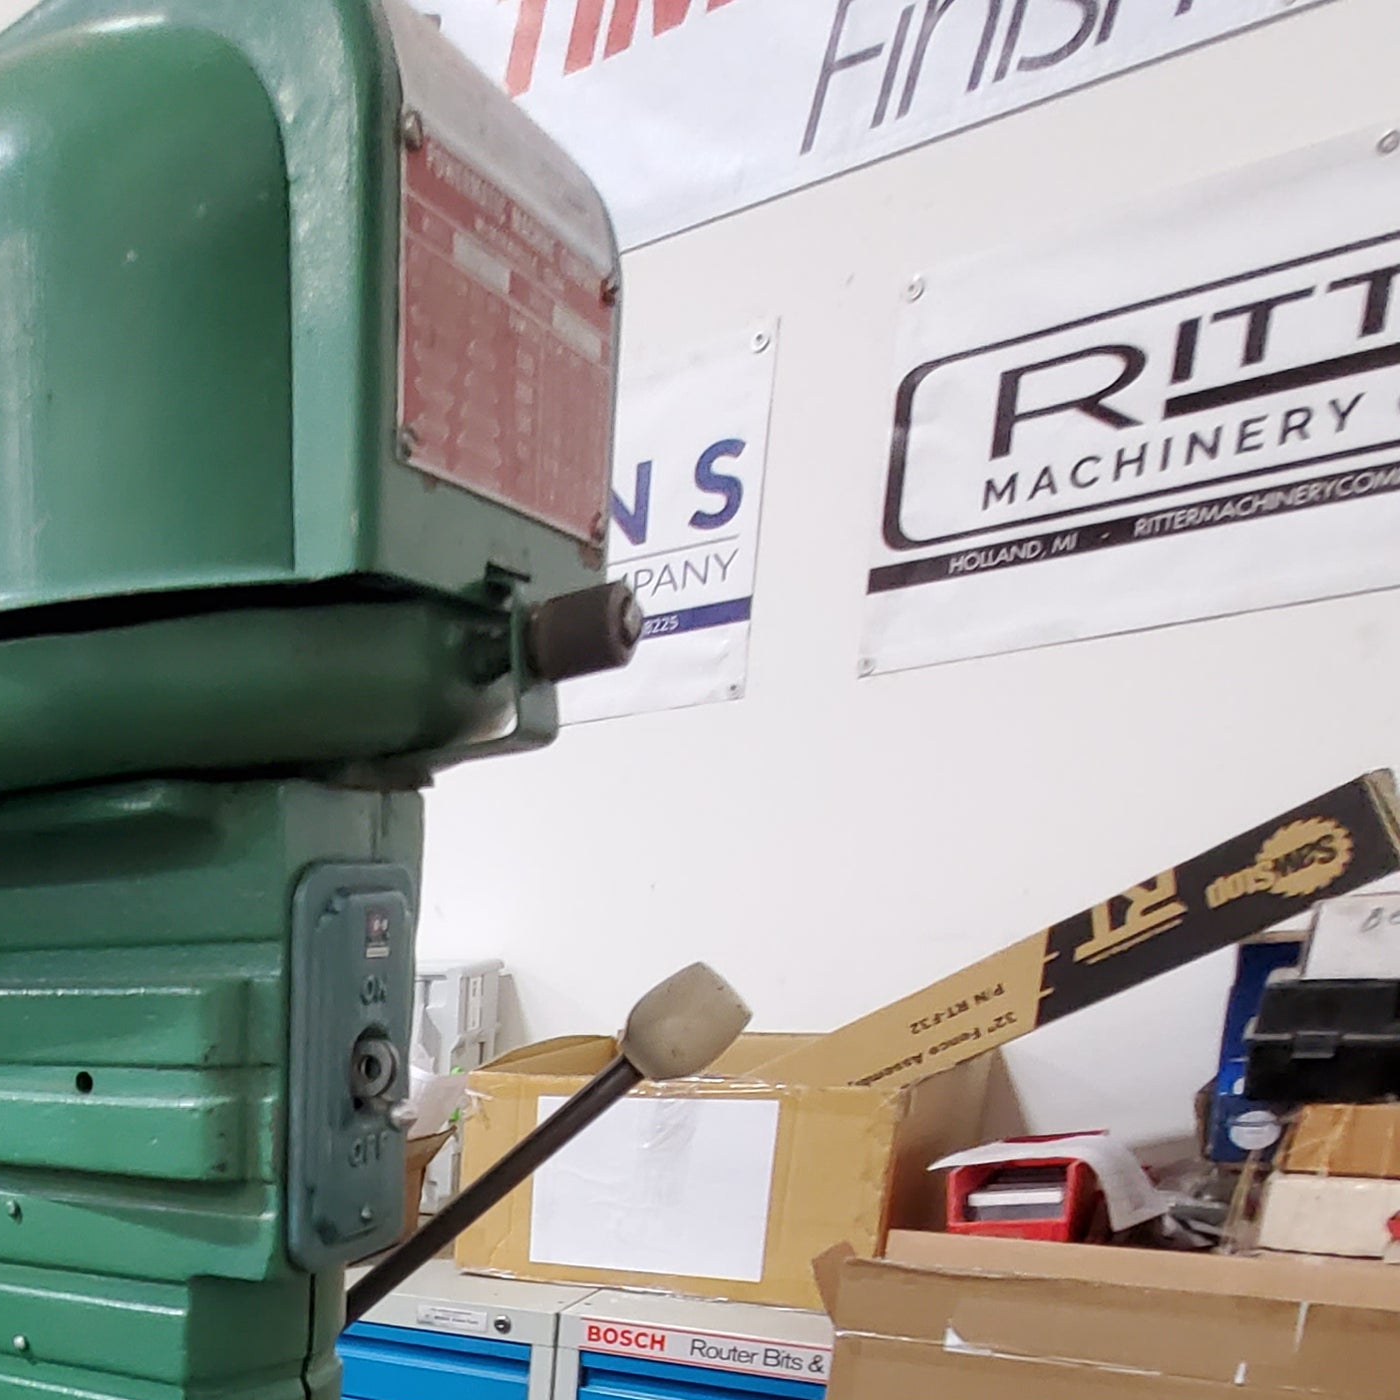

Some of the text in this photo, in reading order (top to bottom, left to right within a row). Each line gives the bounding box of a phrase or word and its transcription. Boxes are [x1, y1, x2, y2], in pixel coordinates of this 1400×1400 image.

[981, 392, 1366, 512] MACHINERY
[622, 548, 740, 597] PANY
[948, 540, 1047, 575] HOLLAND,
[1051, 532, 1079, 554] MI
[587, 1325, 825, 1375] BOSCH Router Bits &
